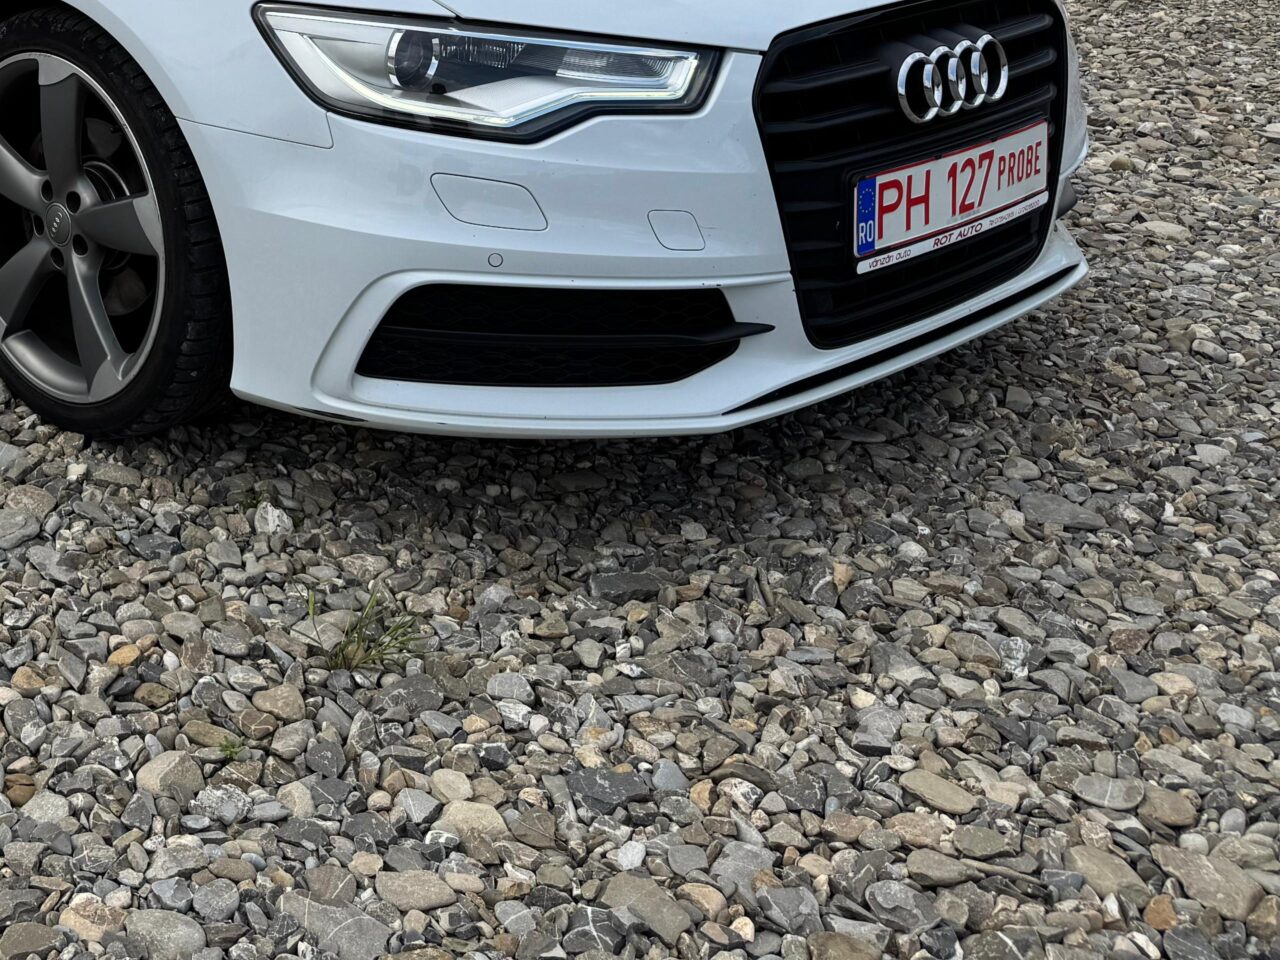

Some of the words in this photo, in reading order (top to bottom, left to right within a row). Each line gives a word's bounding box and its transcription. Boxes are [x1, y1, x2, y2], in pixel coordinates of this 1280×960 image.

[877, 169, 931, 240] PH
[947, 149, 995, 217] 127
[997, 140, 1042, 191] PROBE
[858, 220, 874, 245] RO
[932, 233, 954, 248] ROT
[956, 222, 983, 240] AUTO
